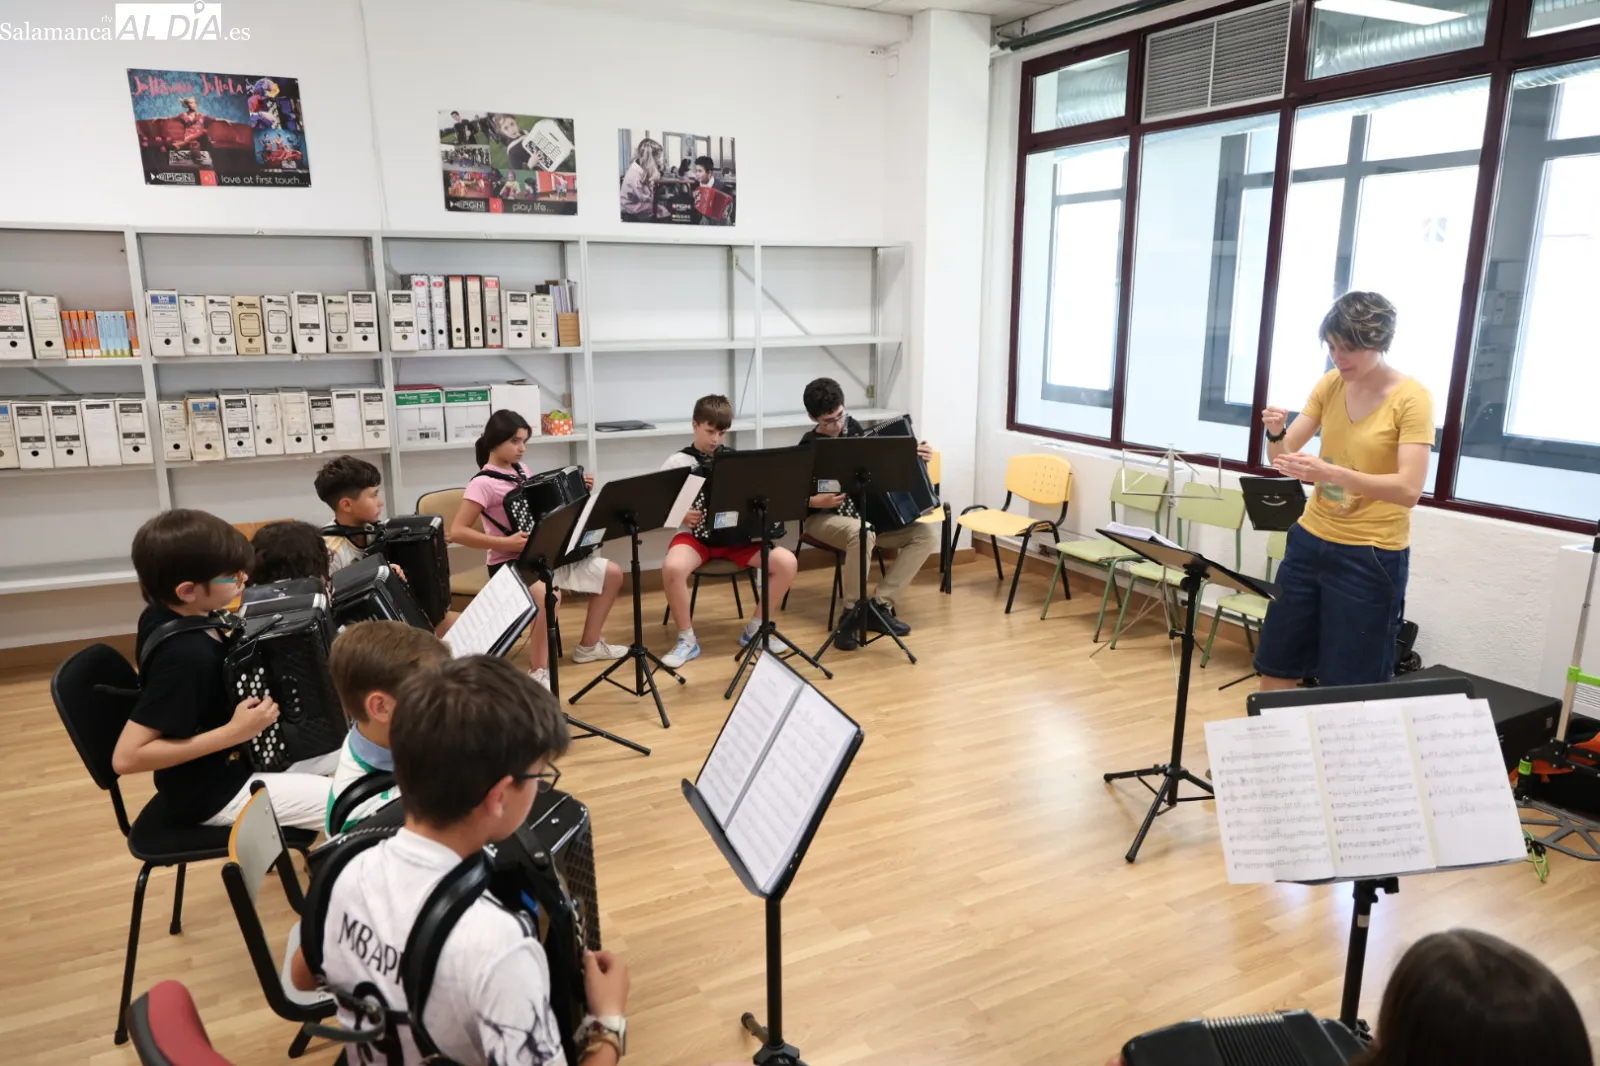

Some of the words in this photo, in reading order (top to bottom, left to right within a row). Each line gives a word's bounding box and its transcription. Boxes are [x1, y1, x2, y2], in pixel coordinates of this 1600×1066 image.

[221, 175, 241, 184] love
[243, 175, 254, 184] at
[256, 175, 273, 184] first
[512, 202, 532, 212] play
[338, 911, 404, 985] MBAP
